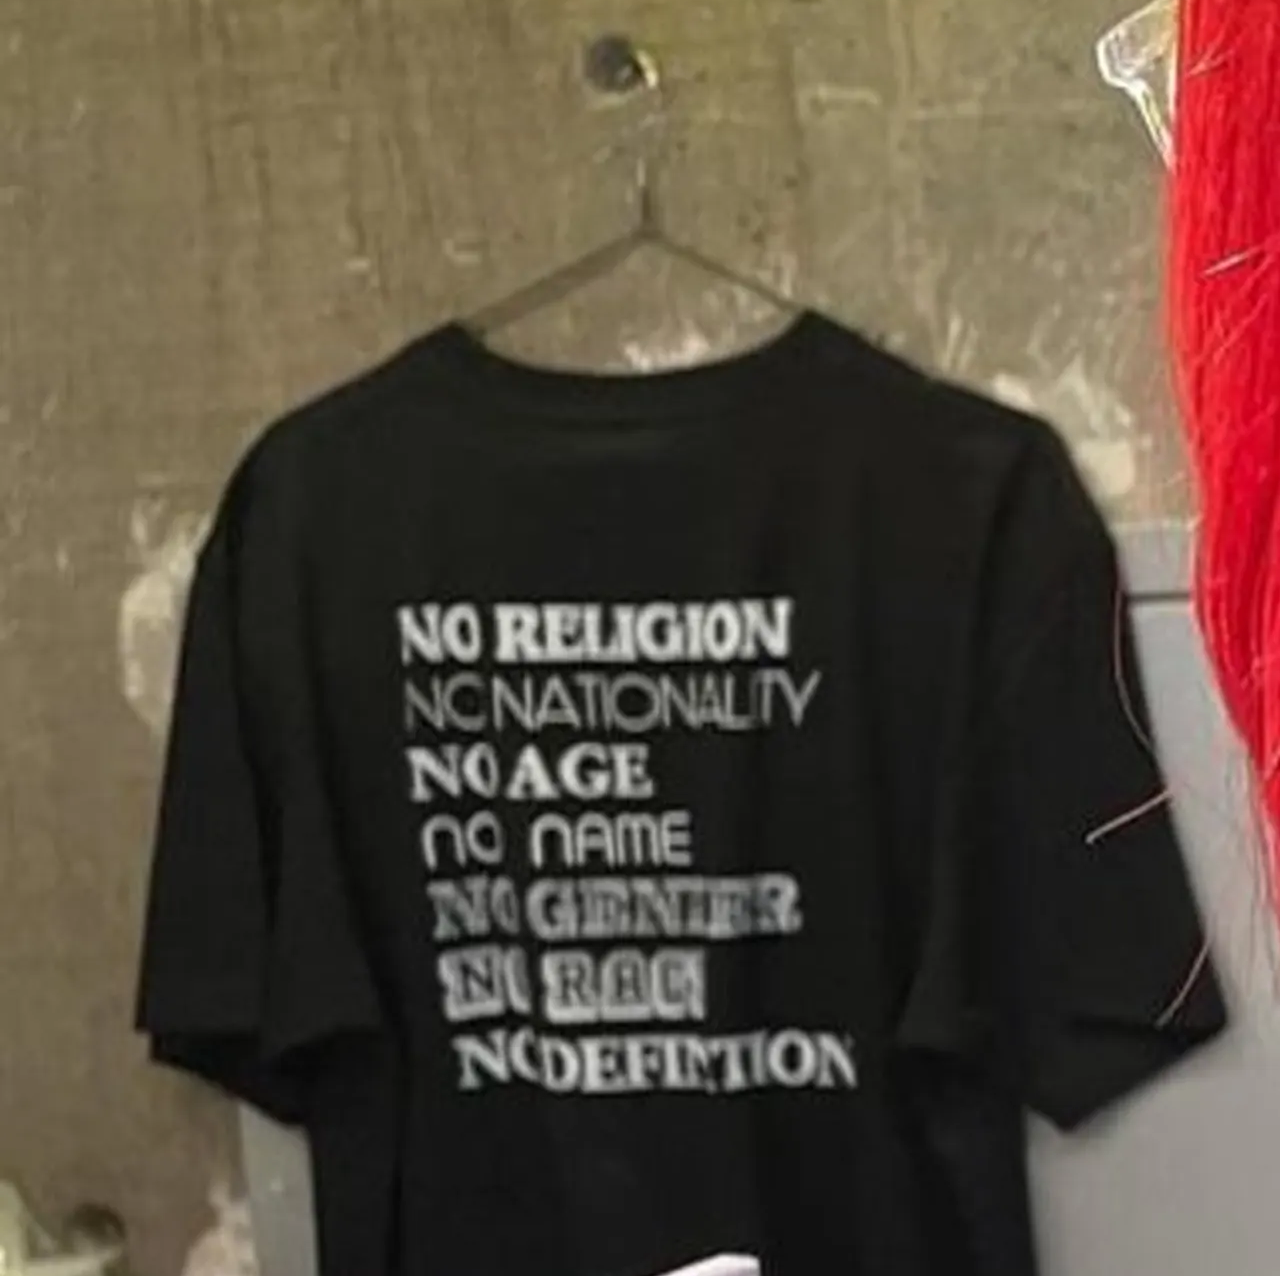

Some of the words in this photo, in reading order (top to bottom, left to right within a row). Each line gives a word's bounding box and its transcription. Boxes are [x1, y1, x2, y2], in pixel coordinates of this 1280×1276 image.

[398, 603, 484, 666] NO
[493, 596, 793, 663] RELIGION
[491, 669, 822, 732] NATIONALITY
[406, 742, 500, 802] NO
[506, 741, 655, 800] AGE
[427, 874, 521, 942] NO
[539, 946, 707, 1025] RAC
[540, 1027, 858, 1094] DEFINTION
